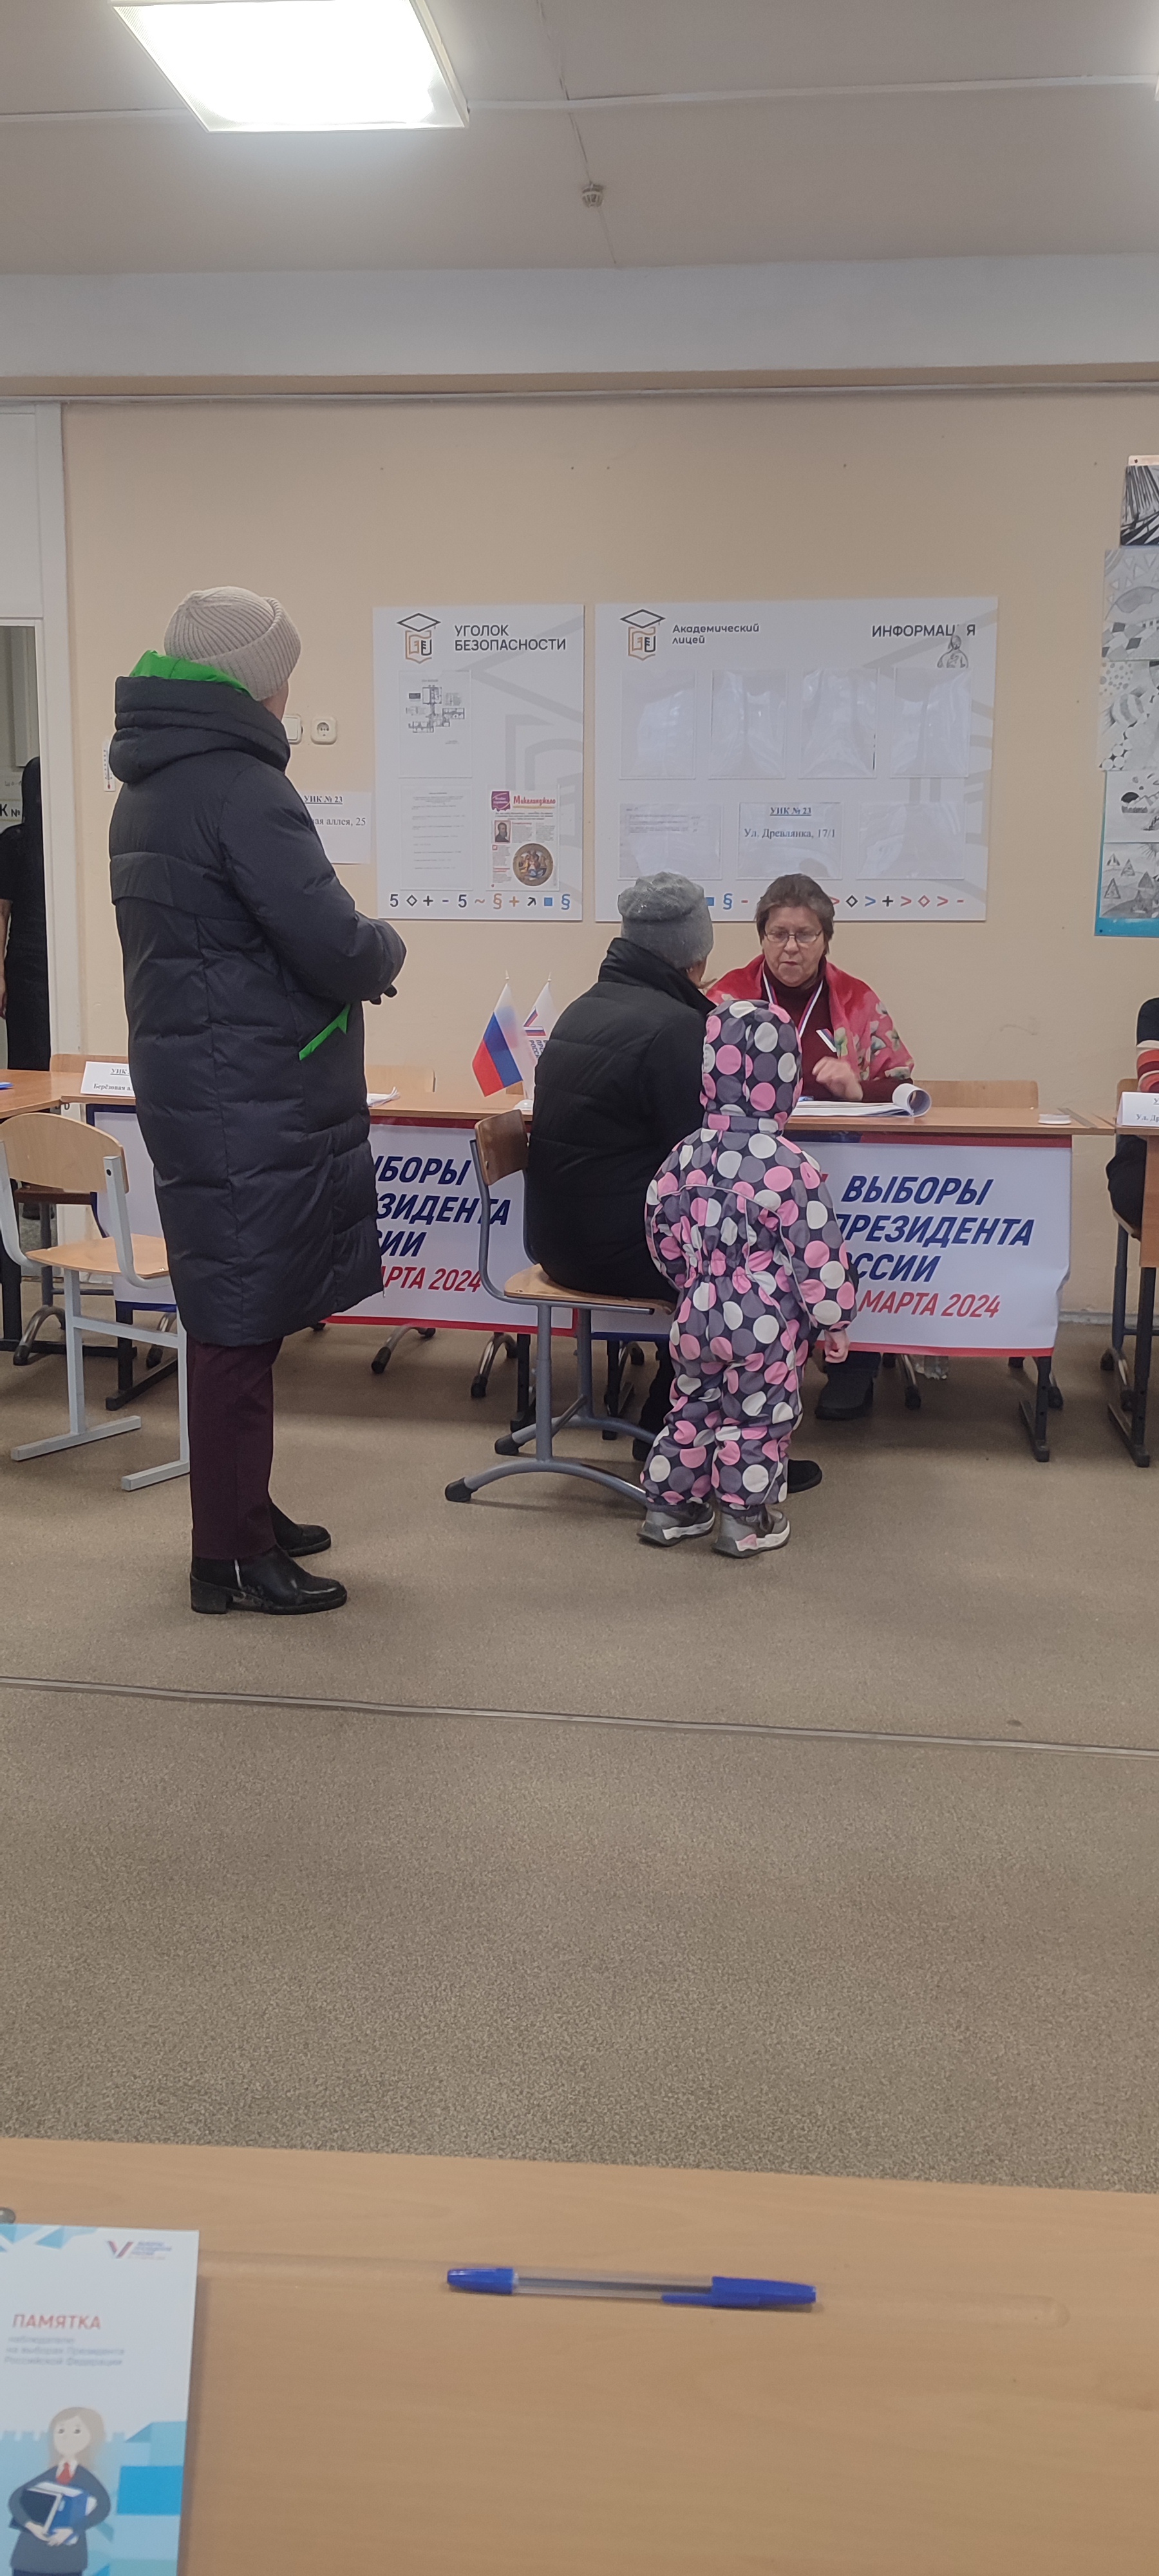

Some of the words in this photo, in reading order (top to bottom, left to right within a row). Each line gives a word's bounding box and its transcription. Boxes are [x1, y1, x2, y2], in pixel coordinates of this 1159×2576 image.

[454, 624, 509, 637] УГОЛОК
[672, 623, 760, 634] Академический
[872, 623, 976, 638] ИНФОРМАЦЯ
[455, 638, 567, 651] БЕЗОПАСНОСТИ
[672, 635, 706, 645] лицей
[770, 807, 789, 816] УИК
[803, 807, 812, 815] 23
[355, 817, 366, 826] 25
[744, 828, 760, 838] Ул.
[762, 828, 815, 840] Древлянка,
[818, 829, 836, 838] 17/1
[375, 1156, 471, 1186] БОРЫ
[840, 1175, 994, 1206] ВЫБОРЫ
[377, 1193, 511, 1226] ЗИДЕНА
[846, 1251, 941, 1282] ССИИ
[428, 1268, 482, 1293] 2024
[858, 1289, 939, 1316] МАРТА
[941, 1293, 1001, 1318] 2024
[12, 2315, 101, 2329] ПАМЯТКА
